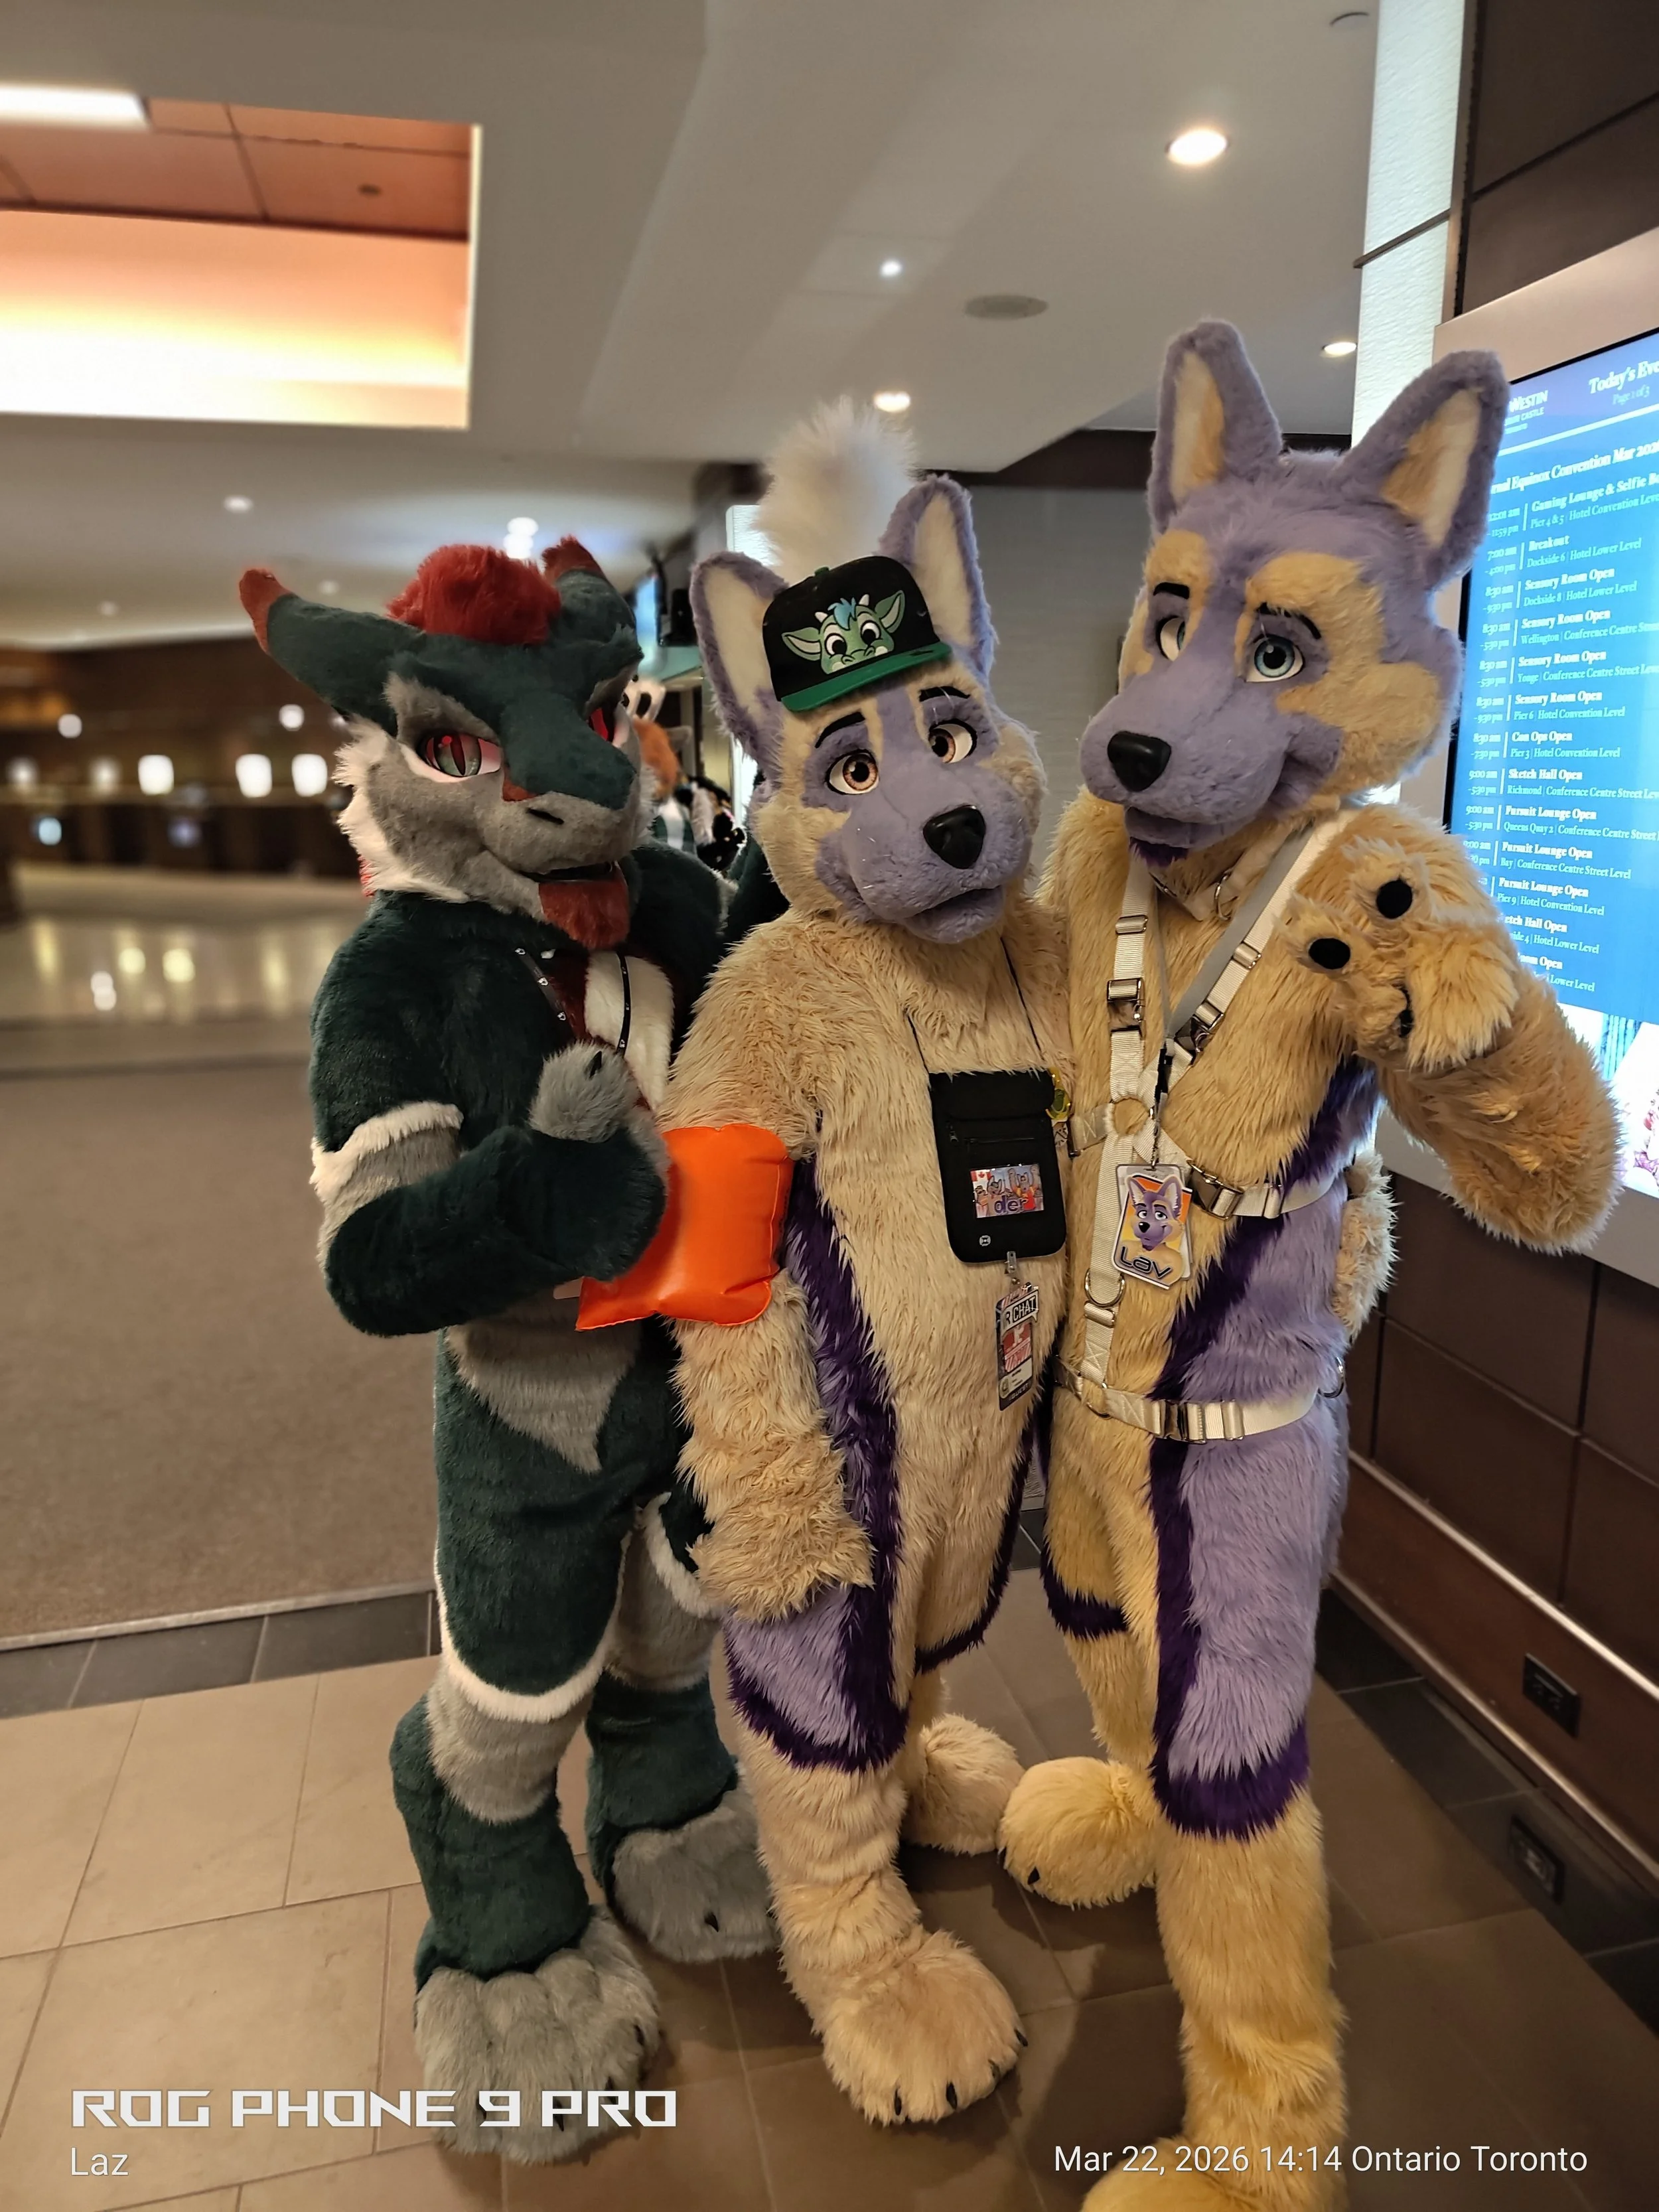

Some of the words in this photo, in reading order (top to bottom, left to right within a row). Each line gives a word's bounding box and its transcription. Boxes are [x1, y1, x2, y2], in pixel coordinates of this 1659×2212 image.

[1589, 366, 1636, 394] Today's
[1490, 477, 1511, 494] rnal
[1511, 471, 1551, 491] Equinox
[1551, 455, 1611, 479] Convention
[1612, 447, 1636, 463] Mar
[1532, 497, 1567, 512] Gaming
[1569, 488, 1605, 504] Lounge
[1605, 483, 1615, 495] &
[1617, 476, 1647, 492] Selfie
[1530, 518, 1546, 528] Pier
[1546, 518, 1551, 527] 4
[1551, 514, 1559, 524] &
[1559, 515, 1565, 525] 5
[1569, 506, 1591, 520] Hotel
[1591, 498, 1639, 515] Convention
[1504, 546, 1517, 555] am
[1527, 553, 1559, 567] Dockside
[1560, 552, 1565, 561] 6
[1570, 547, 1592, 560] Hotel
[1592, 545, 1619, 556] Lower
[1619, 537, 1642, 552] Level
[1528, 536, 1570, 552] Breakout
[1504, 564, 1516, 575] pm
[1525, 577, 1560, 590] Sensory
[1561, 573, 1588, 585] Room
[1589, 568, 1615, 583] Open
[1502, 585, 1514, 594] am
[1524, 593, 1556, 607] Dockside
[1566, 588, 1588, 601] Hotel
[1588, 587, 1615, 597] Lower
[1615, 580, 1638, 594] Level
[1501, 601, 1513, 612] pm
[1498, 623, 1511, 632] am
[1521, 617, 1556, 629] Sensory
[1557, 613, 1584, 625] Room
[1585, 609, 1611, 625] Open
[1520, 633, 1559, 646] Wellington
[1563, 628, 1609, 640] Conference
[1609, 625, 1638, 635] Centre
[1498, 639, 1510, 650] pm
[1495, 660, 1508, 669] am
[1518, 656, 1553, 668] Sensory
[1553, 652, 1580, 664] Room
[1581, 650, 1607, 664] Open
[1494, 677, 1506, 687] pm
[1518, 673, 1540, 684] Yonge
[1543, 670, 1586, 681] Conference
[1586, 668, 1614, 678] Centre
[1615, 666, 1640, 676] Street
[1515, 694, 1549, 707] Sensory
[1550, 692, 1576, 703] Room
[1577, 690, 1603, 705] Open
[1491, 713, 1503, 723] pm
[1514, 711, 1528, 720] Pier
[1528, 711, 1534, 719] 6
[1538, 709, 1558, 719] Hotel
[1559, 708, 1603, 718] Convention
[1603, 705, 1626, 717] Level
[1512, 731, 1530, 742] Con
[1530, 731, 1548, 745] Ops
[1548, 731, 1573, 745] Open
[1488, 751, 1500, 761] pm
[1510, 748, 1525, 757] Pier
[1524, 749, 1530, 759] 3
[1534, 747, 1554, 757] Hotel
[1554, 747, 1598, 757] Convention
[1599, 747, 1621, 757] Level
[1508, 769, 1537, 779] Sketch
[1539, 769, 1557, 779] Hall
[1558, 769, 1583, 783] Open
[1485, 786, 1496, 796] pm
[1507, 784, 1542, 795] Richmond
[1546, 786, 1589, 796] Conference
[1589, 787, 1617, 798] Centre
[1617, 788, 1642, 798] Street
[1538, 807, 1571, 821] Lounge
[1572, 808, 1597, 822] Open
[1482, 822, 1493, 832] pm
[1504, 821, 1528, 832] Queens
[1529, 823, 1548, 836] Quay
[1557, 824, 1602, 836] Conference
[1602, 828, 1630, 838] Centre
[1630, 829, 1657, 841] Street
[1479, 857, 1490, 865] pm
[1534, 844, 1567, 859] Lounge
[1568, 846, 1593, 861] Open
[1500, 857, 1513, 869] Bay
[1517, 859, 1557, 871] Conference
[1558, 863, 1584, 874] Centre
[1584, 865, 1609, 877] Street
[1609, 867, 1632, 879] Level
[1530, 881, 1563, 897] Lounge
[1564, 884, 1589, 899] Open
[1497, 893, 1512, 903] Pier
[1511, 897, 1517, 905] 9
[1520, 895, 1540, 907] Hotel
[1540, 898, 1583, 913] Convention
[1583, 903, 1605, 916] Level
[1504, 915, 1523, 926] etch
[1524, 917, 1543, 928] Hall
[1544, 920, 1567, 934] Open
[1524, 934, 1530, 944] 4
[1534, 934, 1553, 946] Hotel
[1554, 938, 1578, 950] Lower
[1579, 941, 1600, 954] Level
[1518, 952, 1538, 965] oom
[1539, 956, 1563, 970] Open
[1550, 974, 1574, 988] Lower
[1574, 979, 1595, 992] Level
[1013, 1296, 1036, 1322] CHAT
